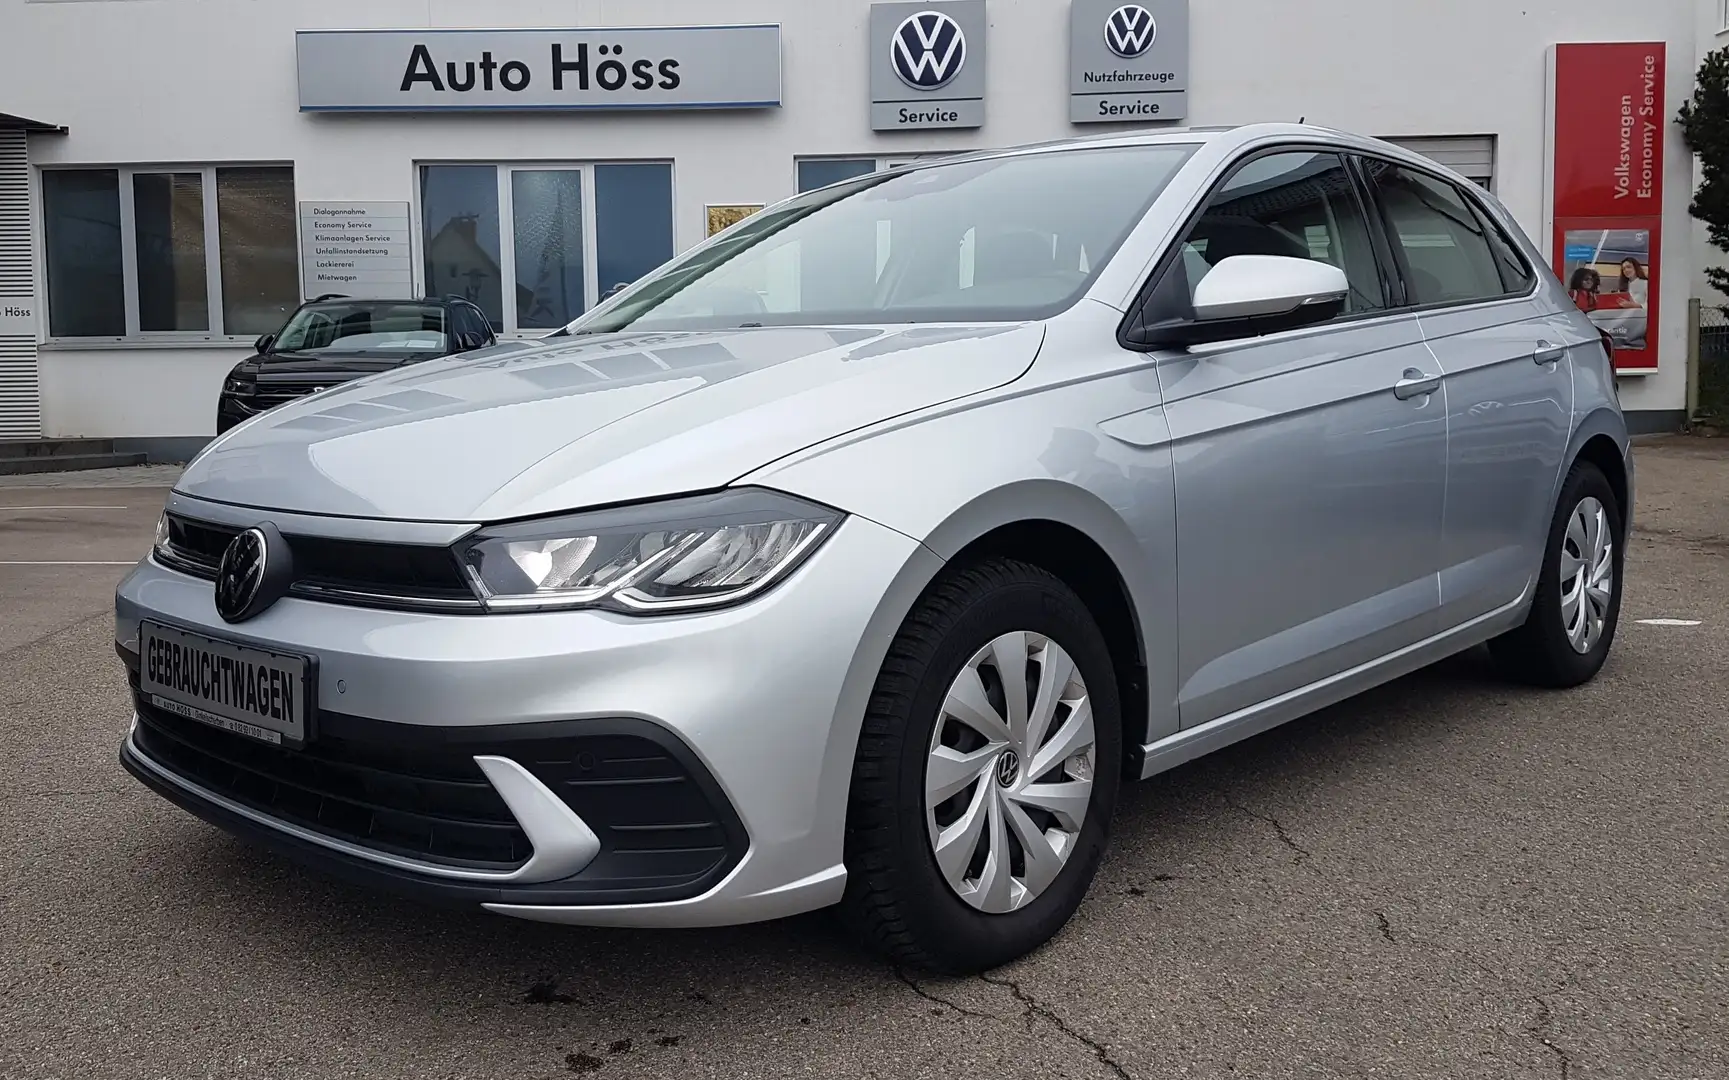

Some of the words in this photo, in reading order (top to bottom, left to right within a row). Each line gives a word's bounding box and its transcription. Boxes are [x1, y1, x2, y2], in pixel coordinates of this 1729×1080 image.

[400, 44, 531, 92] Auto
[551, 43, 681, 91] Höss
[1084, 70, 1175, 83] Nutzfahrzeuge
[1639, 55, 1655, 116] Service
[898, 108, 958, 123] Service
[1098, 101, 1160, 116] Service
[1613, 95, 1635, 199] Volkswagen
[1637, 121, 1656, 198] Economy
[313, 208, 366, 216] Dialogannahme
[315, 234, 364, 243] Klimaanlagen
[317, 274, 357, 282] Mietwagen
[5, 306, 31, 317] Höss
[148, 635, 294, 723] GEBRAUCHTWAGEN
